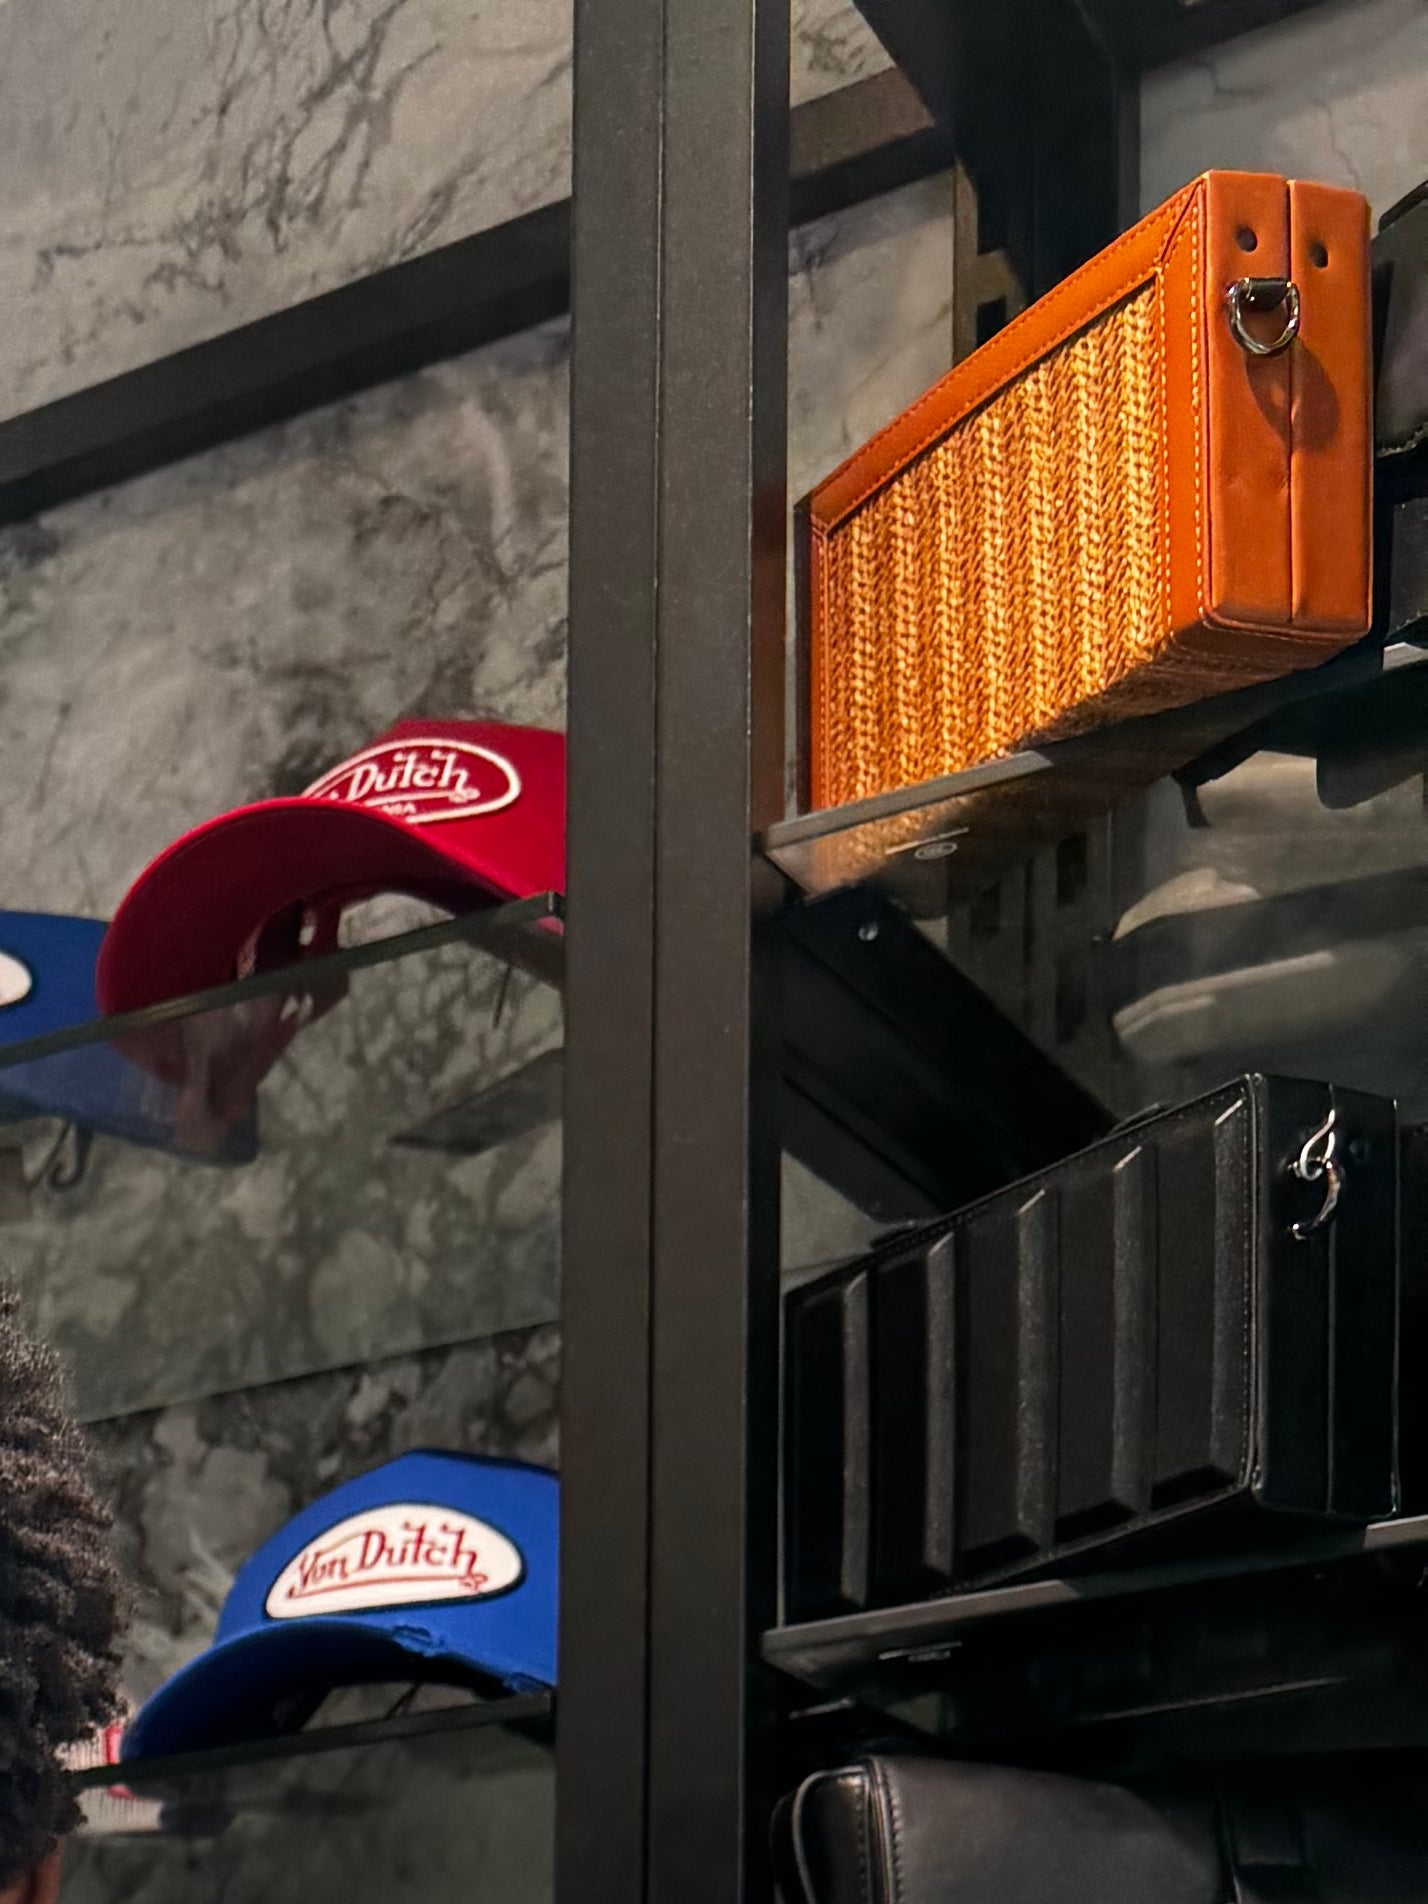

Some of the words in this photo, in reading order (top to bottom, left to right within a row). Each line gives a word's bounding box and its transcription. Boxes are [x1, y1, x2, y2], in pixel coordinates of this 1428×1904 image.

[344, 750, 470, 802] Dutch
[298, 1549, 349, 1591] Von
[356, 1520, 478, 1583] Dutch
